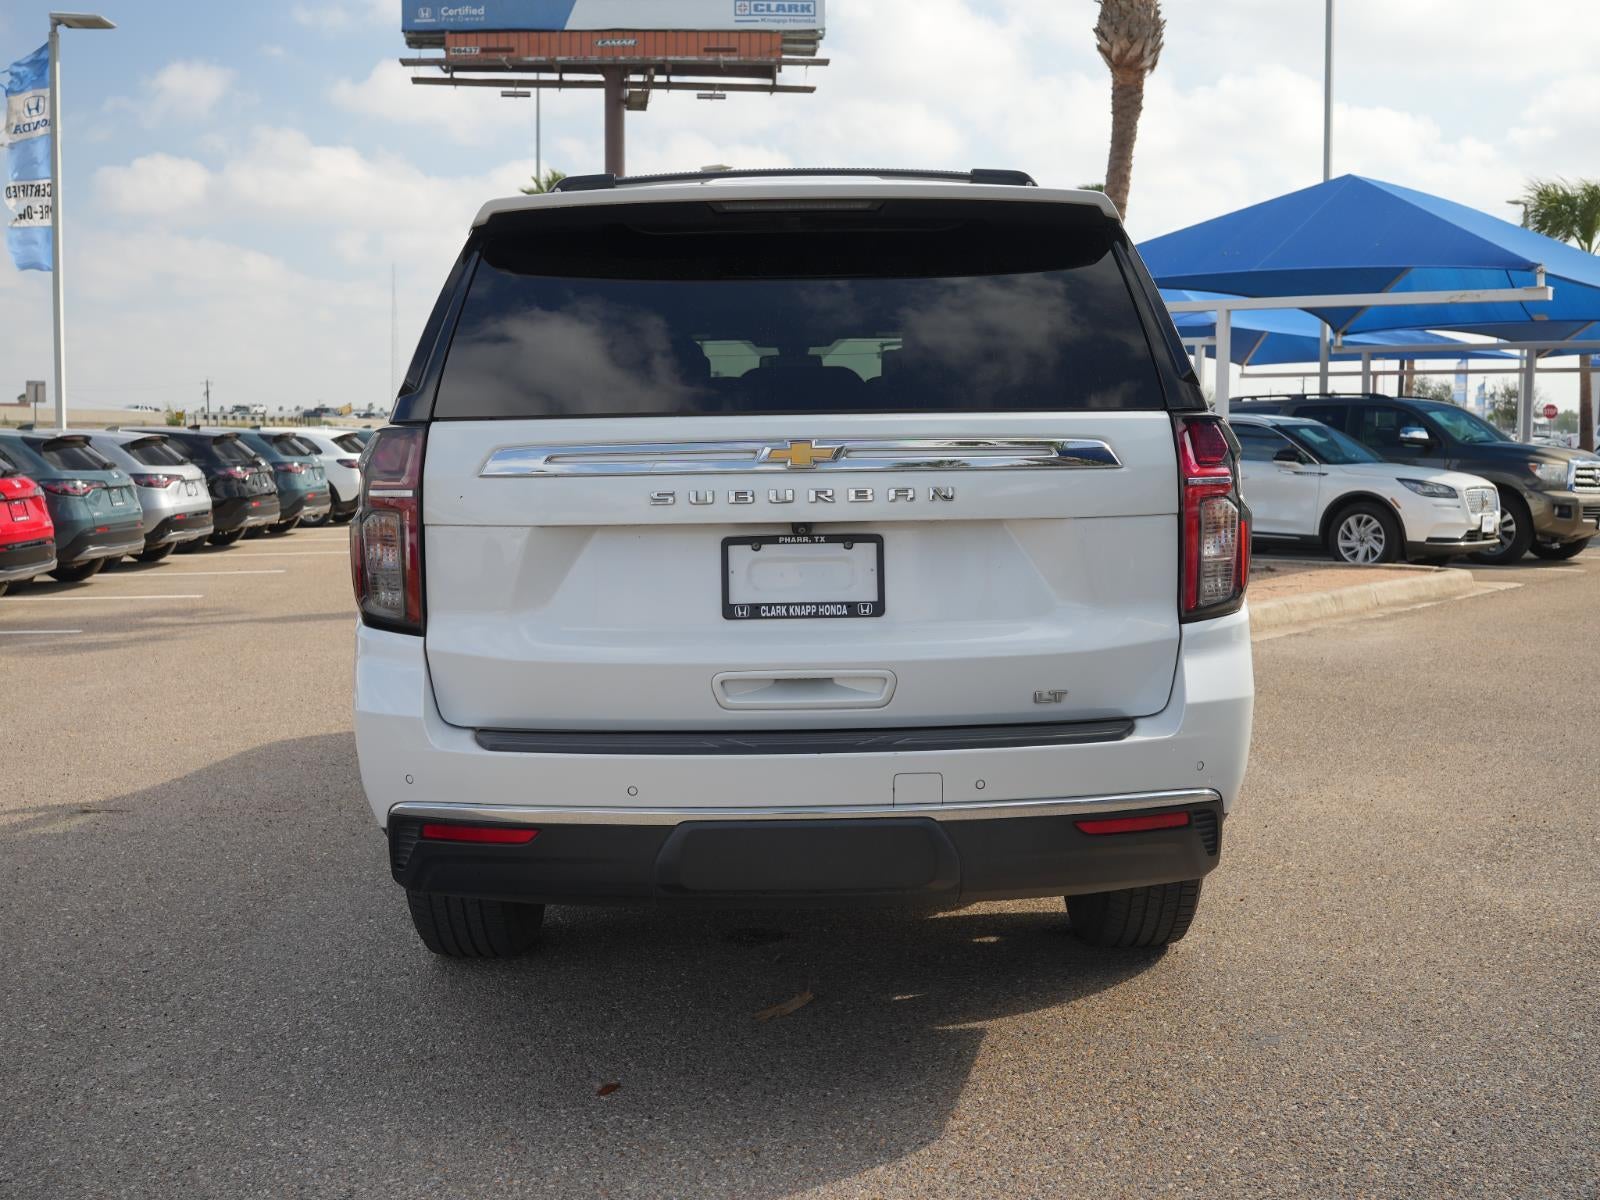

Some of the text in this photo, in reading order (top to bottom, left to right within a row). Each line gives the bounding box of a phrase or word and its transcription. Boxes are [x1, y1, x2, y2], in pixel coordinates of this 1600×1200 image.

[440, 6, 485, 16] Certified
[753, 3, 812, 13] CLARK
[650, 487, 956, 506] SUBURBAN
[760, 604, 847, 617] CLARK KNAPP HONDA
[1033, 689, 1068, 704] LT
